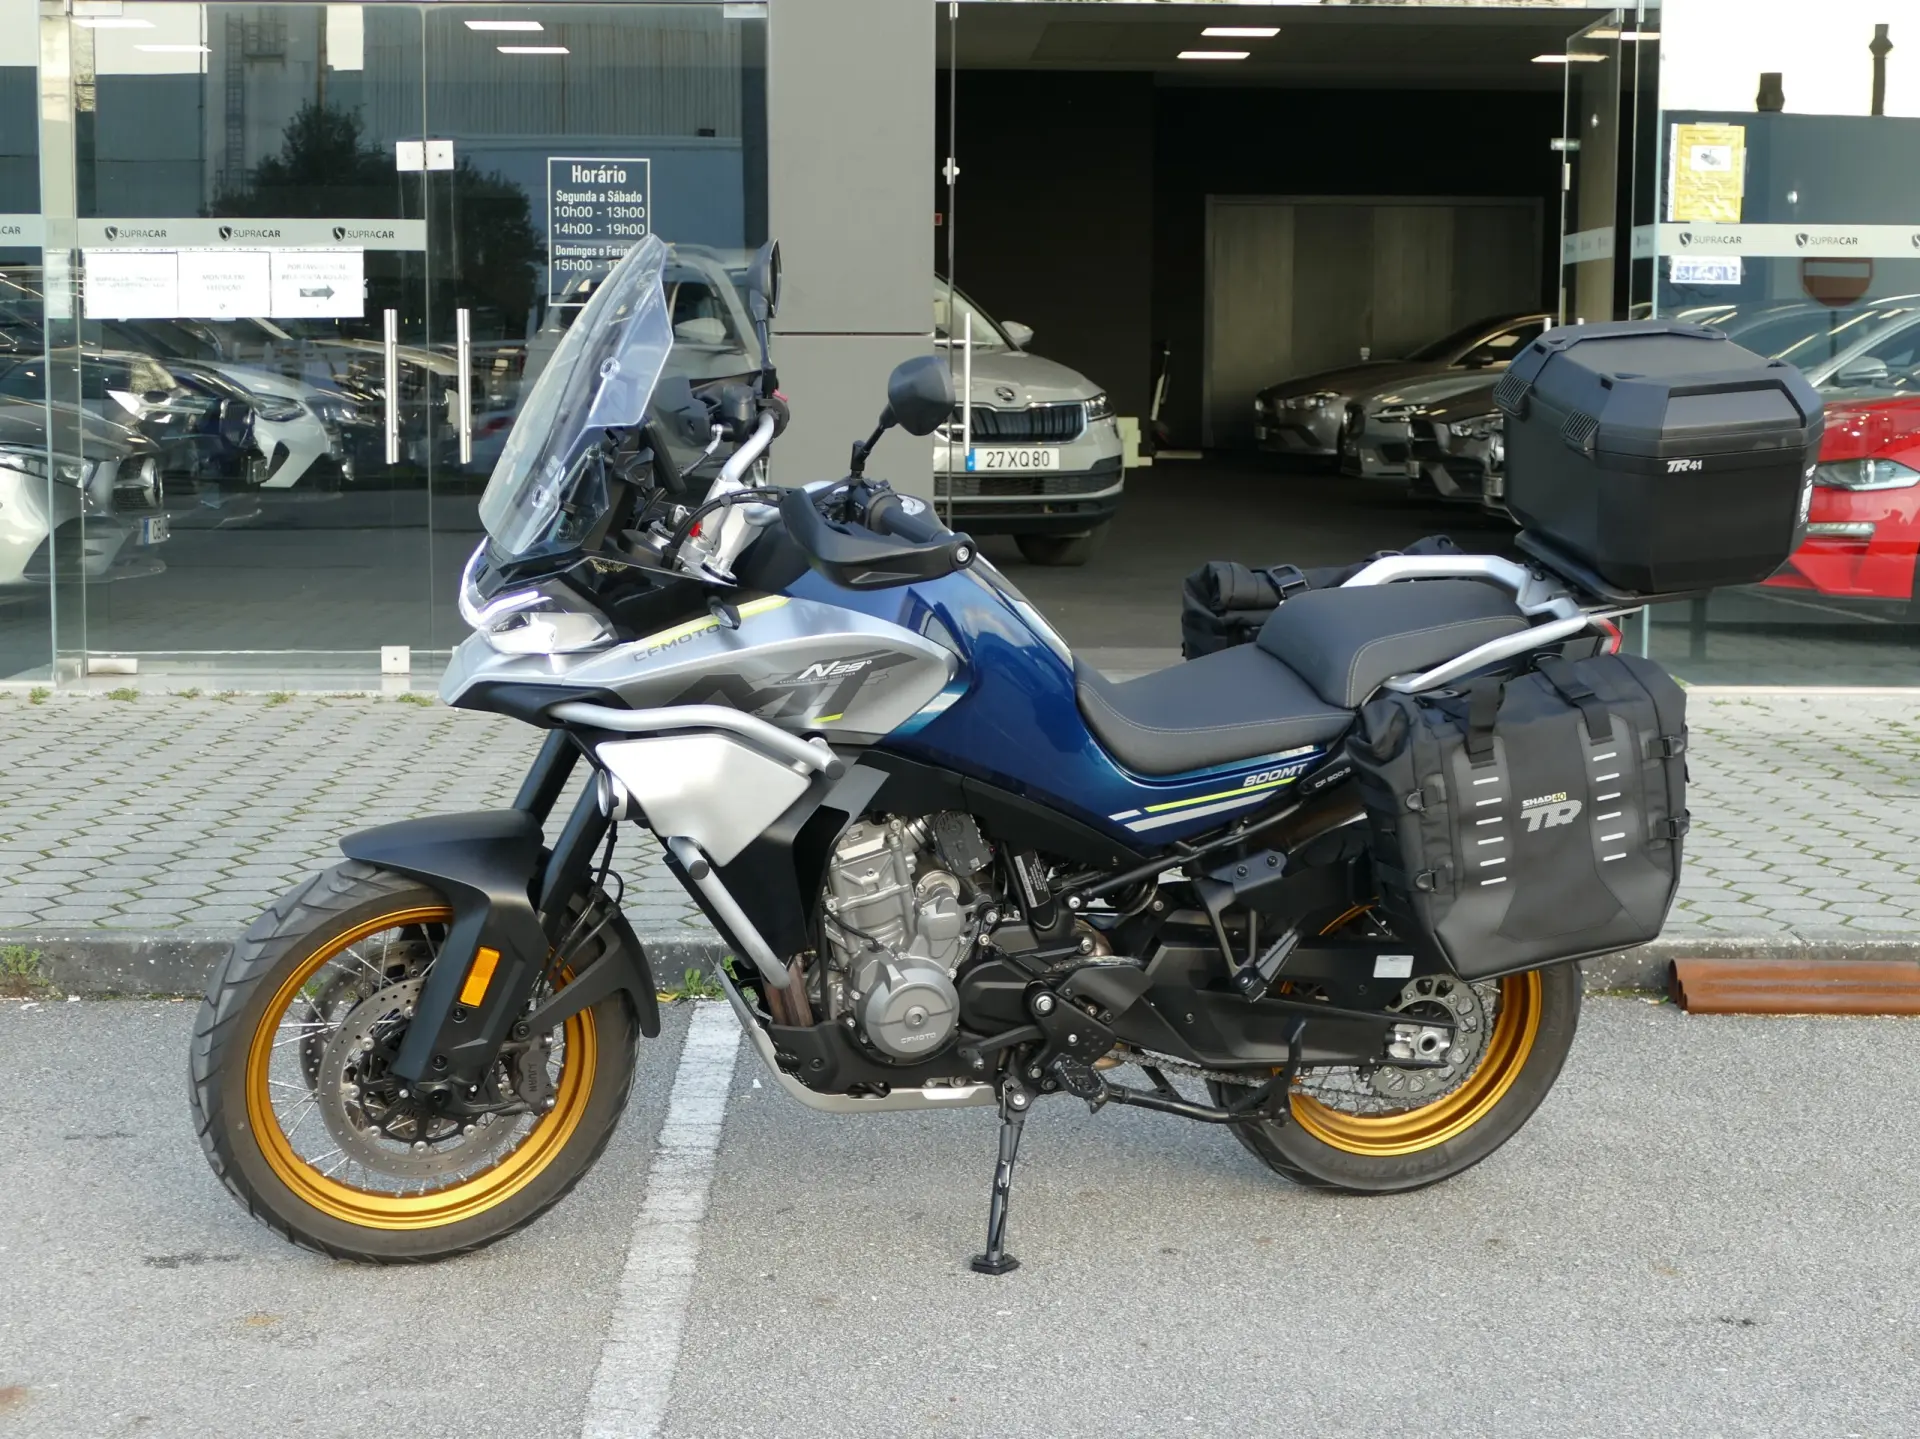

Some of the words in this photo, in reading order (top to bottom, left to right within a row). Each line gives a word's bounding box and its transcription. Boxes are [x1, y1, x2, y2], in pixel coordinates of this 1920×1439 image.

[572, 165, 627, 184] Horário
[556, 190, 597, 204] Segunda
[599, 194, 605, 202] a
[607, 190, 643, 203] Sábado
[554, 206, 593, 218] 10h00
[606, 206, 645, 218] 13h00
[0, 226, 21, 235] CAR
[119, 229, 167, 239] SUPRACAR
[233, 229, 281, 239] SUPRACAR
[347, 230, 395, 239] SUPRACAR
[554, 223, 593, 235] 14h00
[606, 223, 645, 235] 19h00
[1693, 235, 1742, 245] SUPRACAR
[1810, 236, 1858, 246] SUPRACAR
[555, 245, 597, 258] Domingos
[599, 248, 604, 256] e
[554, 259, 593, 271] 15h00
[633, 624, 721, 662] CFMOTO
[1243, 763, 1308, 787] 800MT
[1522, 795, 1552, 807] SHAD
[1520, 800, 1582, 832] TR
[900, 1032, 937, 1044] CFMOTO
